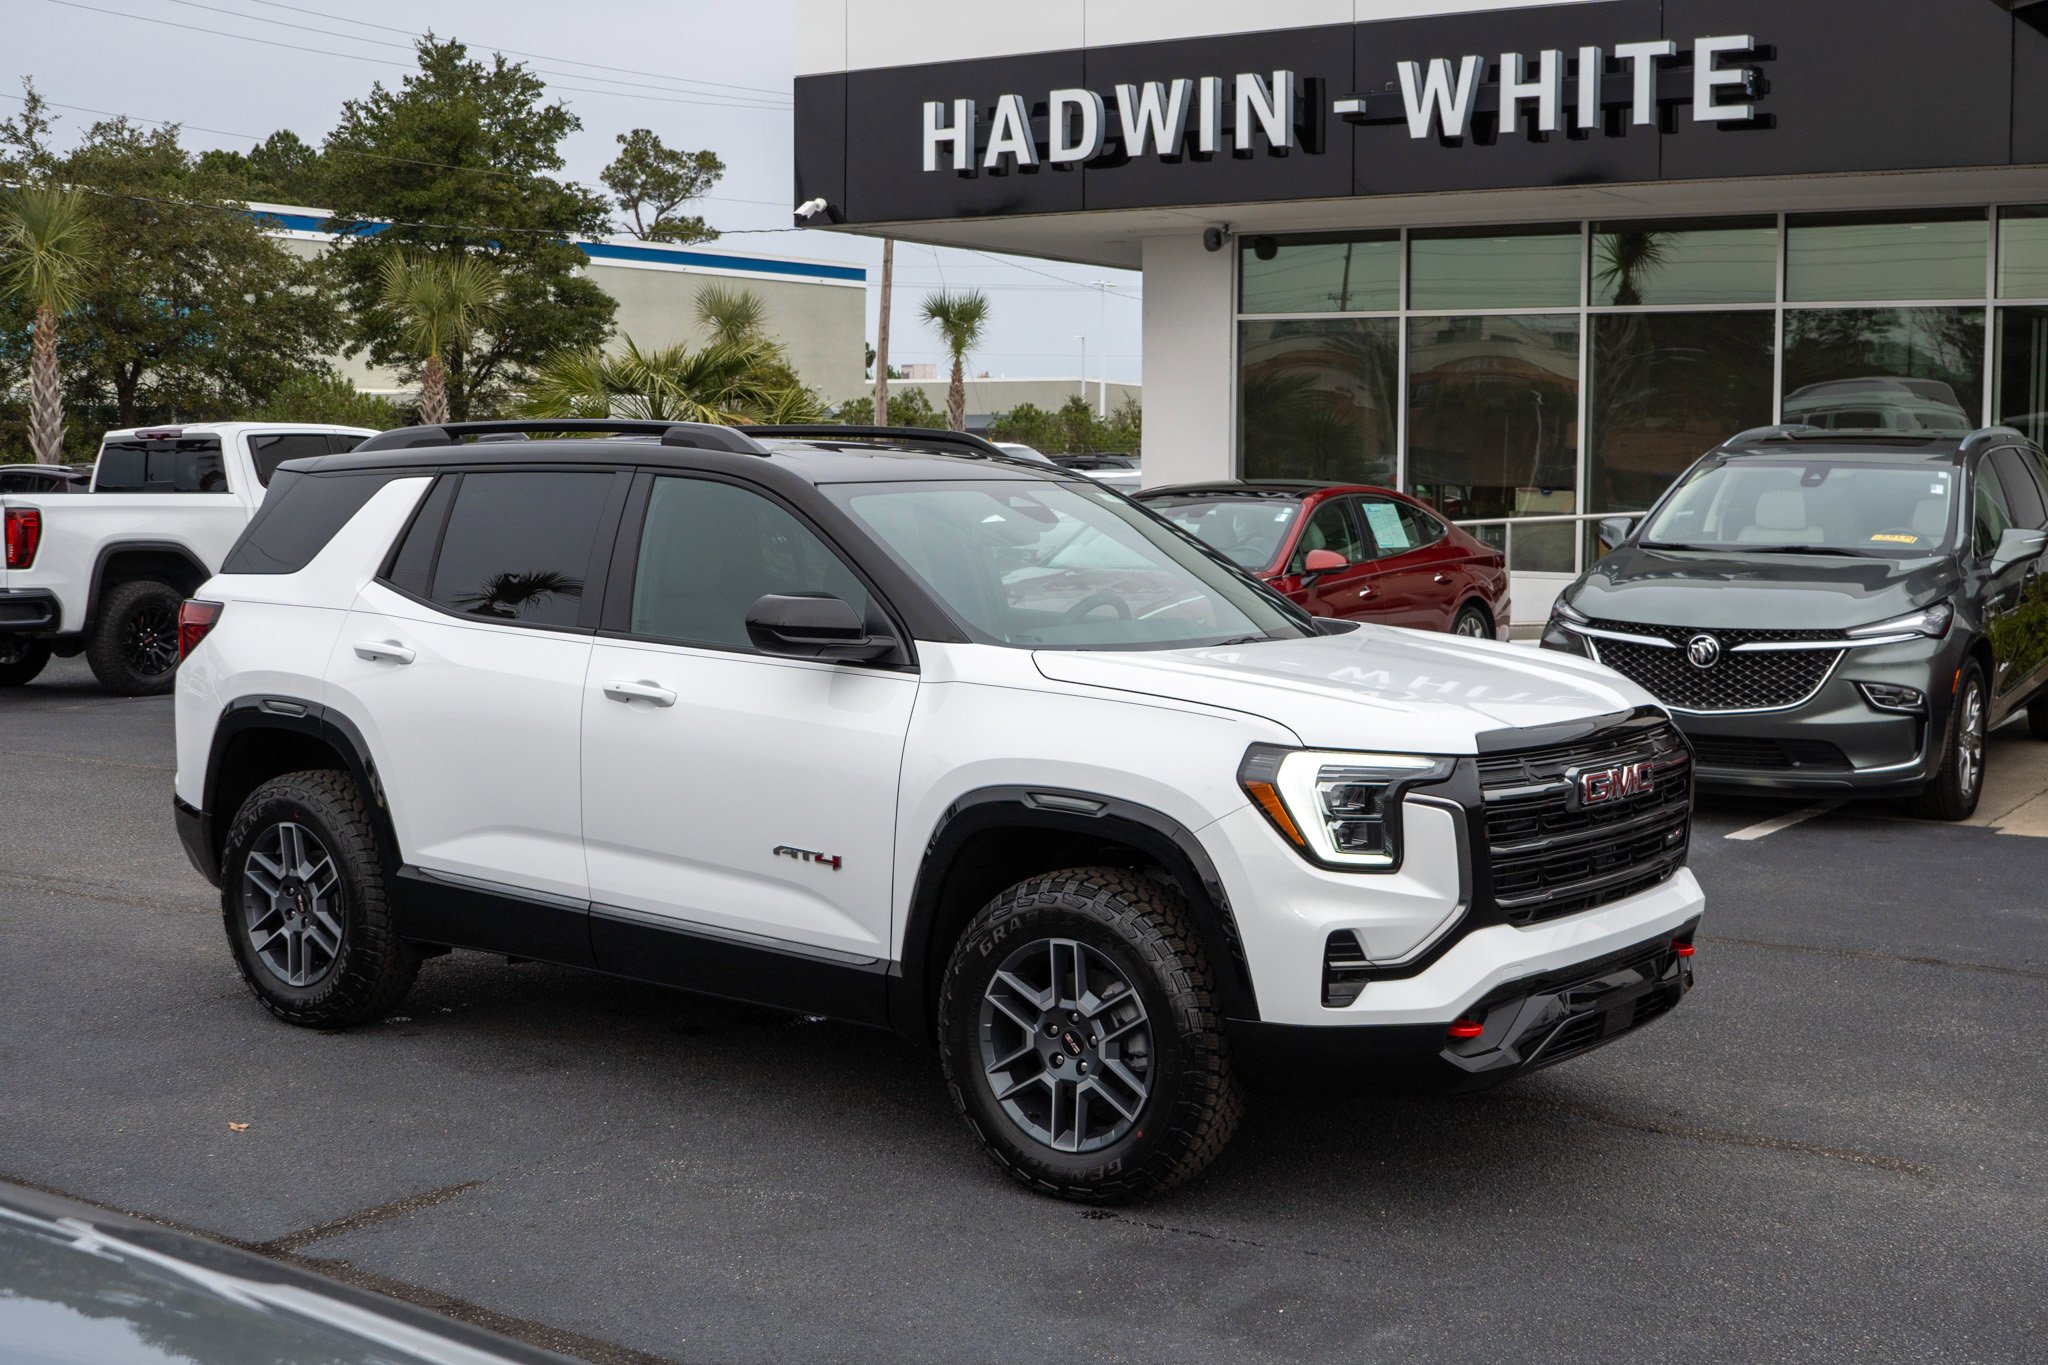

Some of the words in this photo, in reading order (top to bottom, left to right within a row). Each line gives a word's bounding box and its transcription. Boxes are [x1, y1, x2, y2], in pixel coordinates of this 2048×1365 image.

[923, 70, 1293, 171] HADWIN
[1333, 99, 1366, 113] -
[1397, 35, 1754, 139] WHITE
[1581, 761, 1655, 805] GMC
[773, 845, 842, 871] AT4
